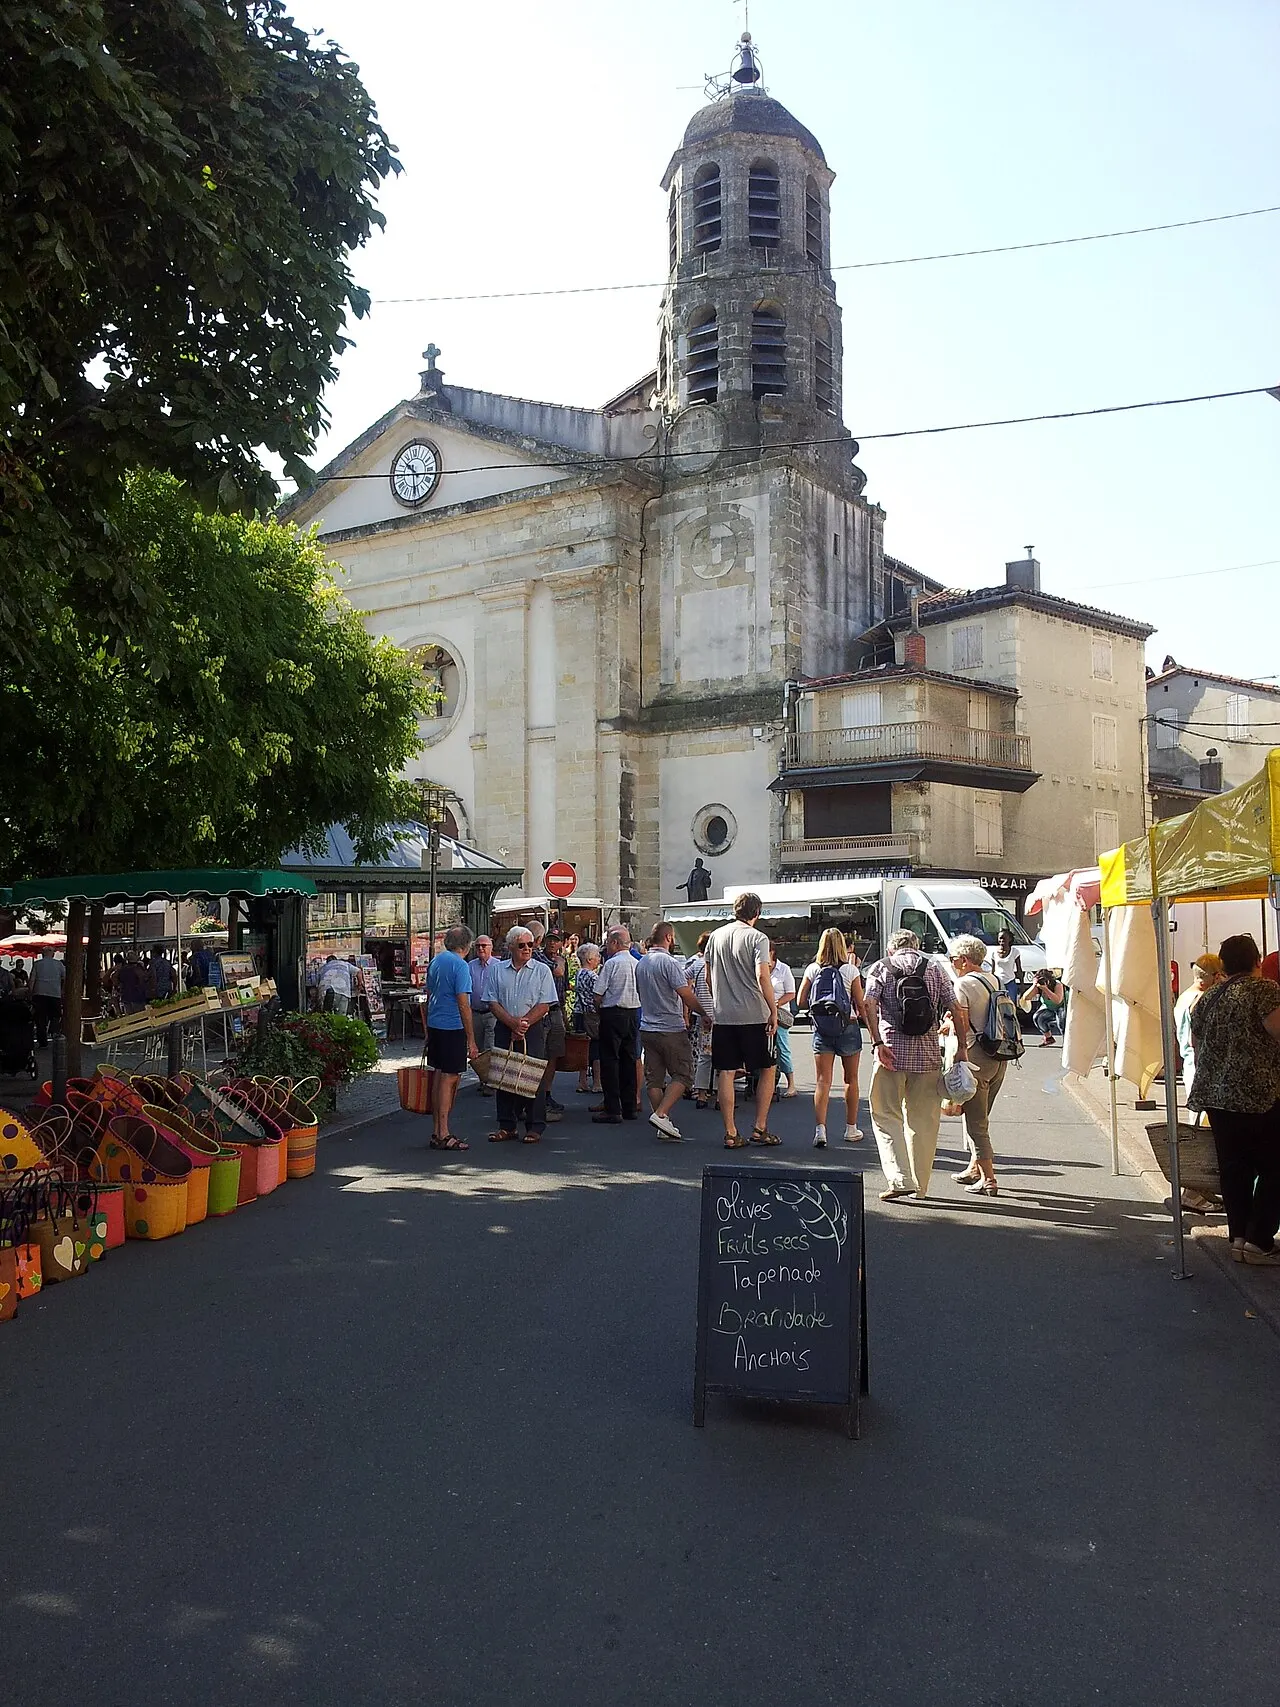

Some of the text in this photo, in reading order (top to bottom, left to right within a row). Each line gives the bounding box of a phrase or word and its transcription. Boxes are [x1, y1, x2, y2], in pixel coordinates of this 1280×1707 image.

[980, 876, 1027, 890] BAZAR
[716, 1180, 774, 1222] Olives
[773, 1233, 811, 1251] secs
[718, 1257, 822, 1301] Tapenade
